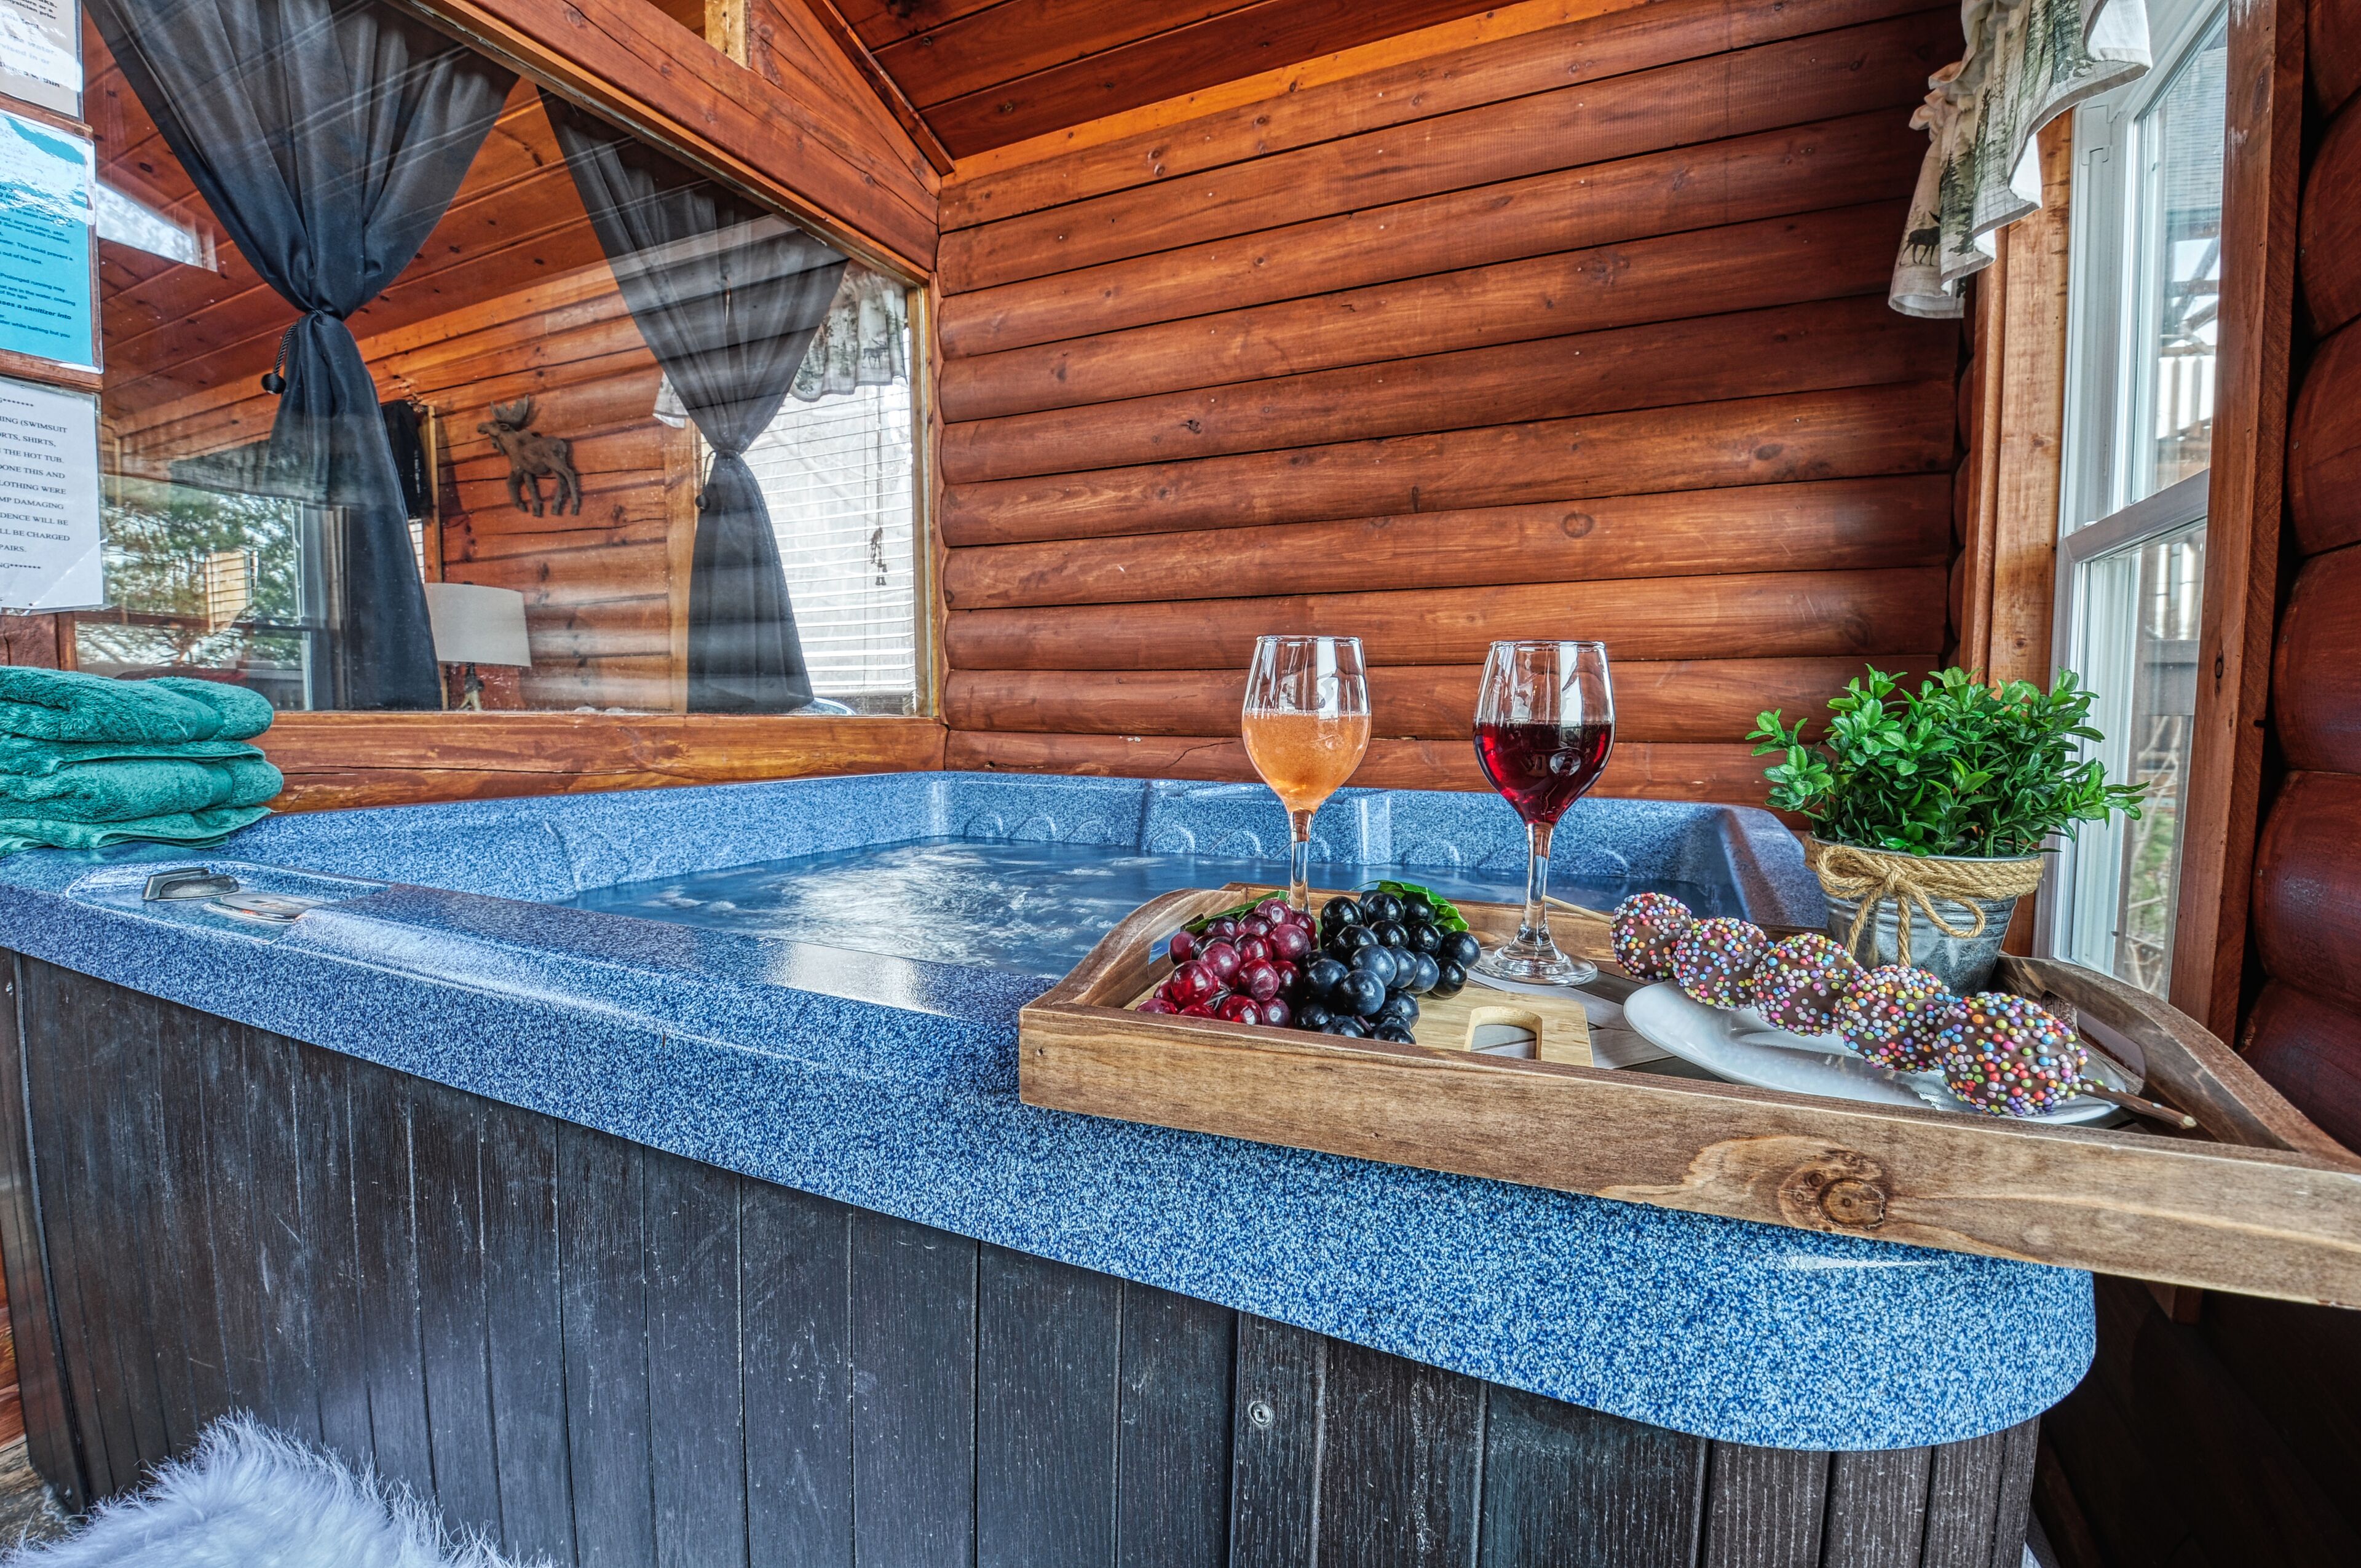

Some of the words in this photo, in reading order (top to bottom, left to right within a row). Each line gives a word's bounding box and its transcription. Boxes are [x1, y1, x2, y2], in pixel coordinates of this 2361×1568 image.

[39, 11, 57, 20] prior
[47, 251, 68, 259] prevent
[0, 272, 30, 283] Prolonged
[31, 280, 52, 290] running
[54, 297, 76, 306] creating
[24, 306, 55, 317] sanitizer
[28, 325, 49, 334] bathing
[20, 419, 68, 433] (SWIMSUIT
[23, 435, 57, 447] SHIRTS,
[23, 451, 42, 460] HOT
[44, 454, 65, 464] TUB.
[23, 467, 44, 476] THIS
[41, 485, 67, 494] WERE
[14, 498, 64, 510] DAMAGING
[33, 516, 55, 525] WILL
[26, 531, 71, 541] CHARGED
